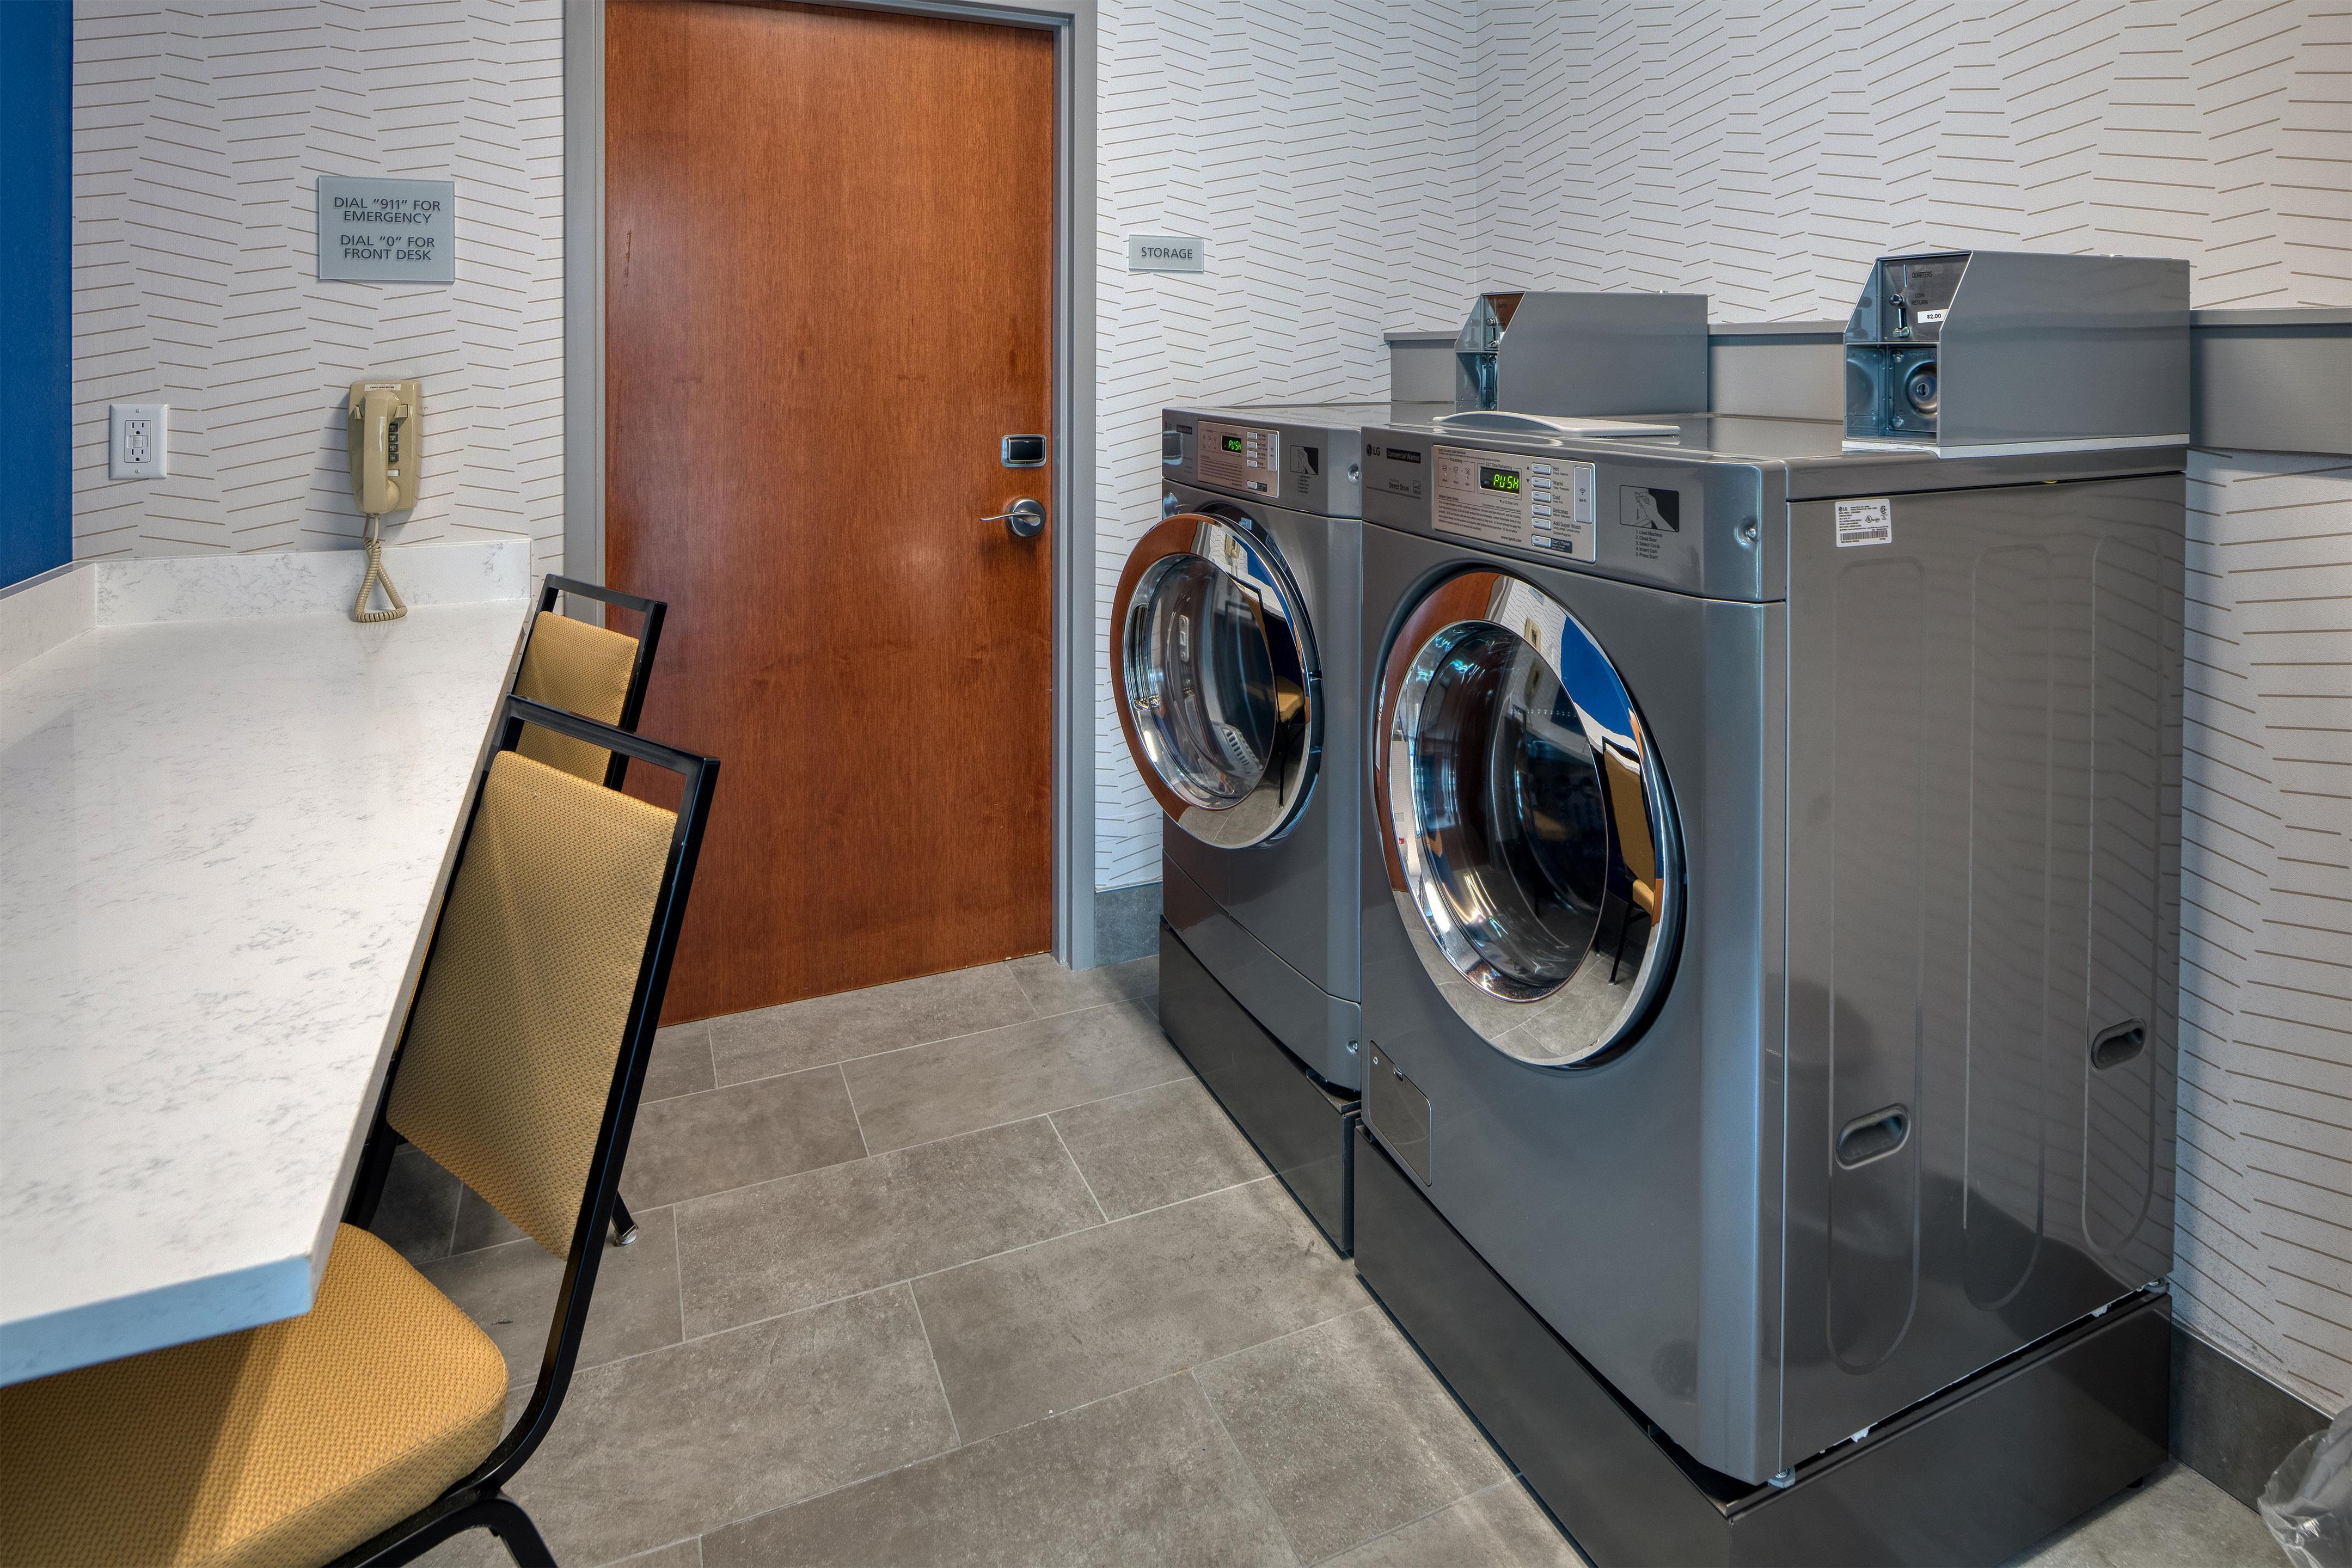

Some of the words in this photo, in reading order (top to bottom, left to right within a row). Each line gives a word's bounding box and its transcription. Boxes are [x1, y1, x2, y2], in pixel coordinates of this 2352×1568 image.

[334, 197, 367, 209] DIAL
[414, 200, 441, 211] FOR
[344, 211, 432, 223] EMERGENCY
[341, 235, 374, 246] DIAL
[408, 237, 435, 247] FOR
[345, 248, 391, 259] FRONT
[397, 249, 432, 260] DESK
[1141, 247, 1193, 259] STORAGE
[1228, 440, 1241, 450] PUSH
[1373, 446, 1381, 456] LG
[1389, 481, 1399, 490] Direct
[1400, 483, 1409, 492] Drive
[1493, 474, 1519, 489] PUSH
